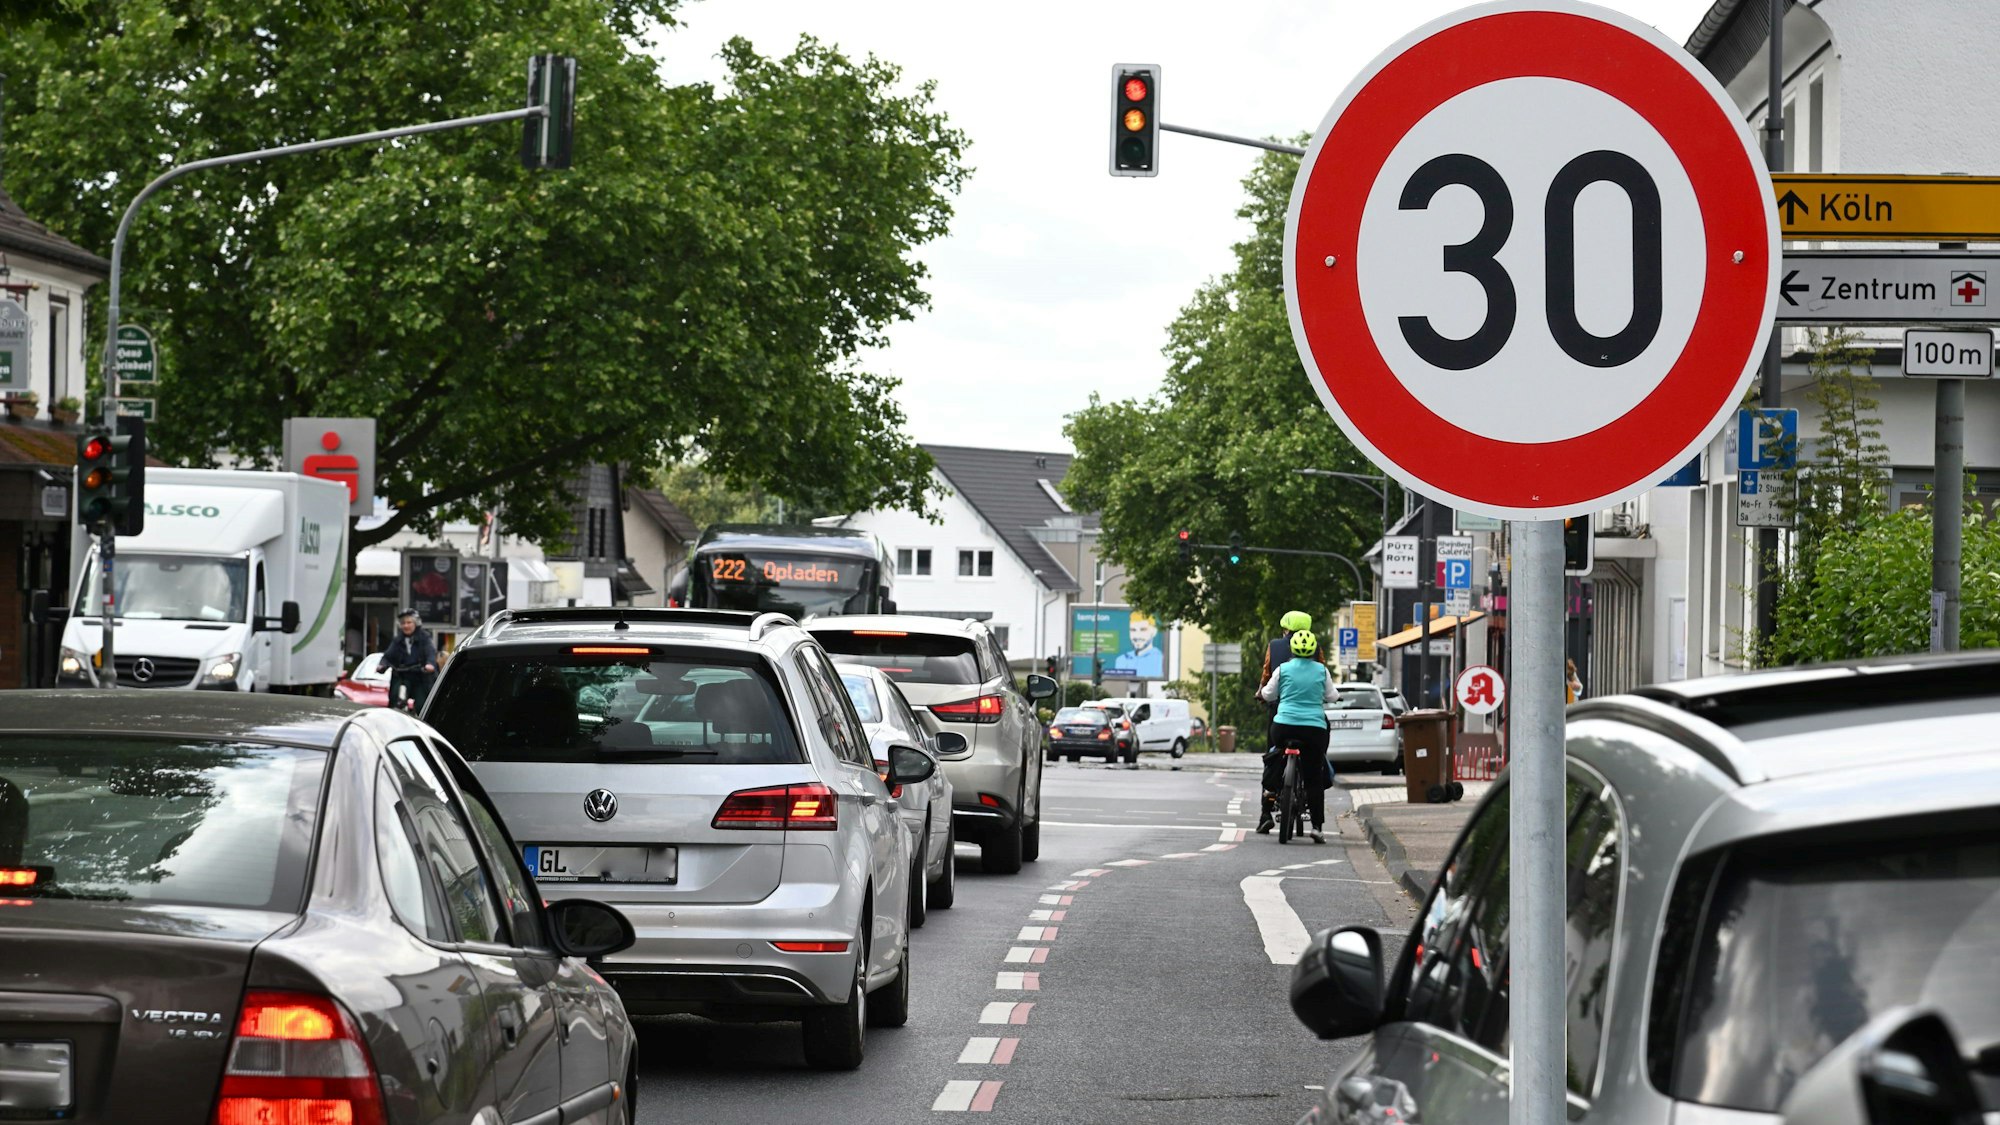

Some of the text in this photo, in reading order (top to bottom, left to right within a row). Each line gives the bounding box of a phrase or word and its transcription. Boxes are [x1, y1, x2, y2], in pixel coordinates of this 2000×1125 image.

[1819, 193, 1893, 222] Köln
[1398, 150, 1663, 371] 30
[1821, 276, 1936, 300] Zentrum
[1740, 500, 1761, 509] Mo-Fr
[1740, 513, 1749, 522] Sa
[1387, 542, 1414, 550] PÜTZ
[1386, 554, 1414, 562] ROTH
[712, 559, 839, 582] 222 Opladen
[540, 850, 566, 873] GL
[131, 1008, 222, 1024] VECTRA
